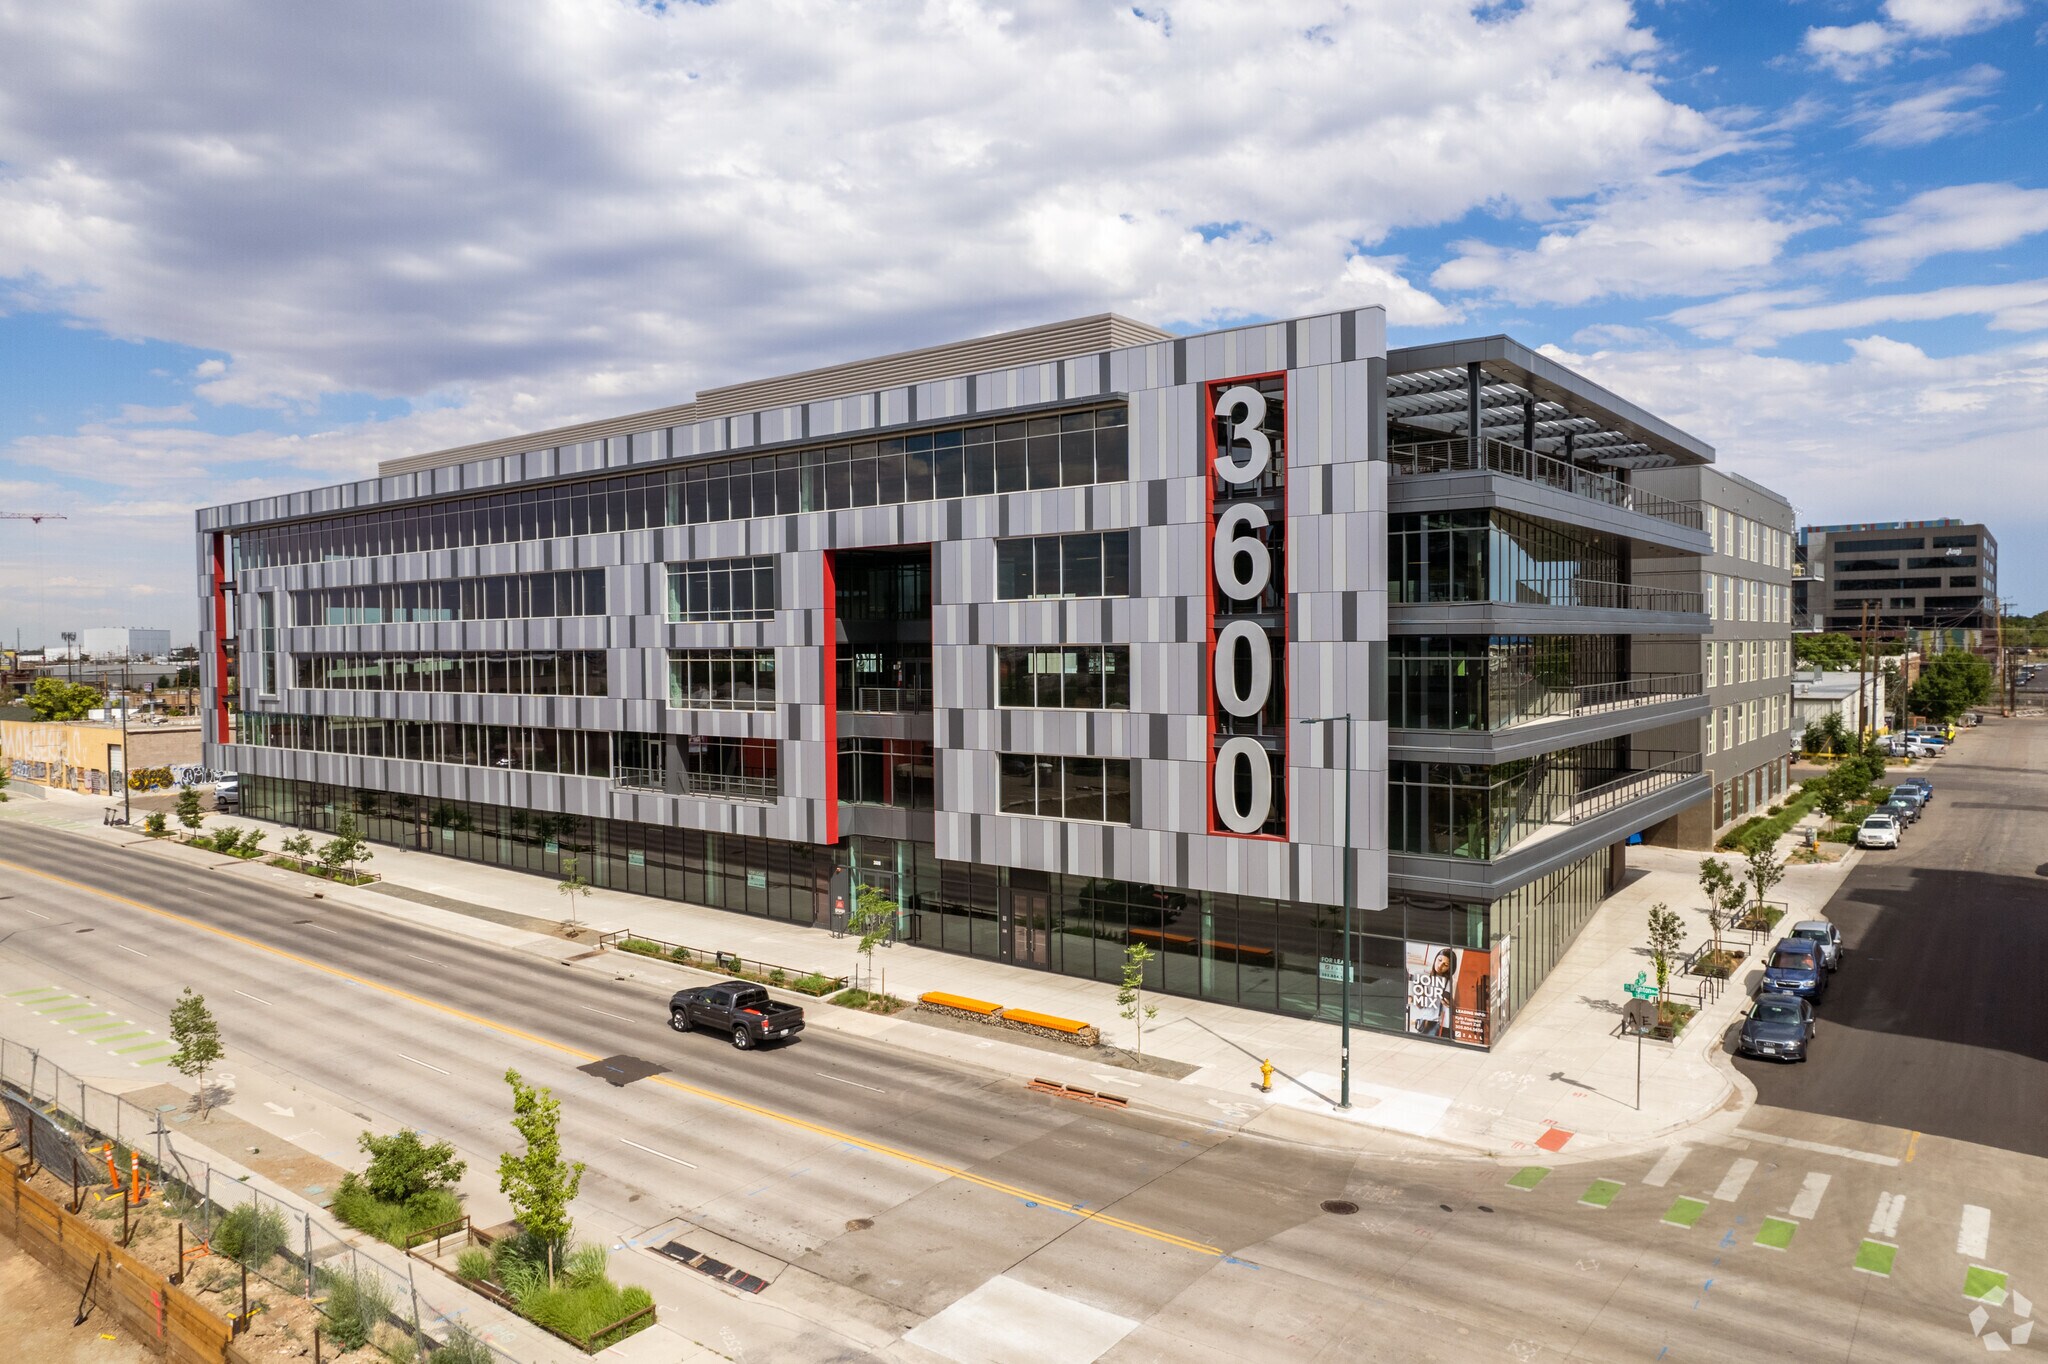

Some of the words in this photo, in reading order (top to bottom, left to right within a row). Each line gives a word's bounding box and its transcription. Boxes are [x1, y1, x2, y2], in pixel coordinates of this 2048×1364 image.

[1214, 386, 1272, 834] 3600
[1334, 958, 1351, 966] LEAE
[1413, 974, 1445, 988] JOIN
[1413, 985, 1443, 999] OUR
[1413, 995, 1438, 1009] MIX
